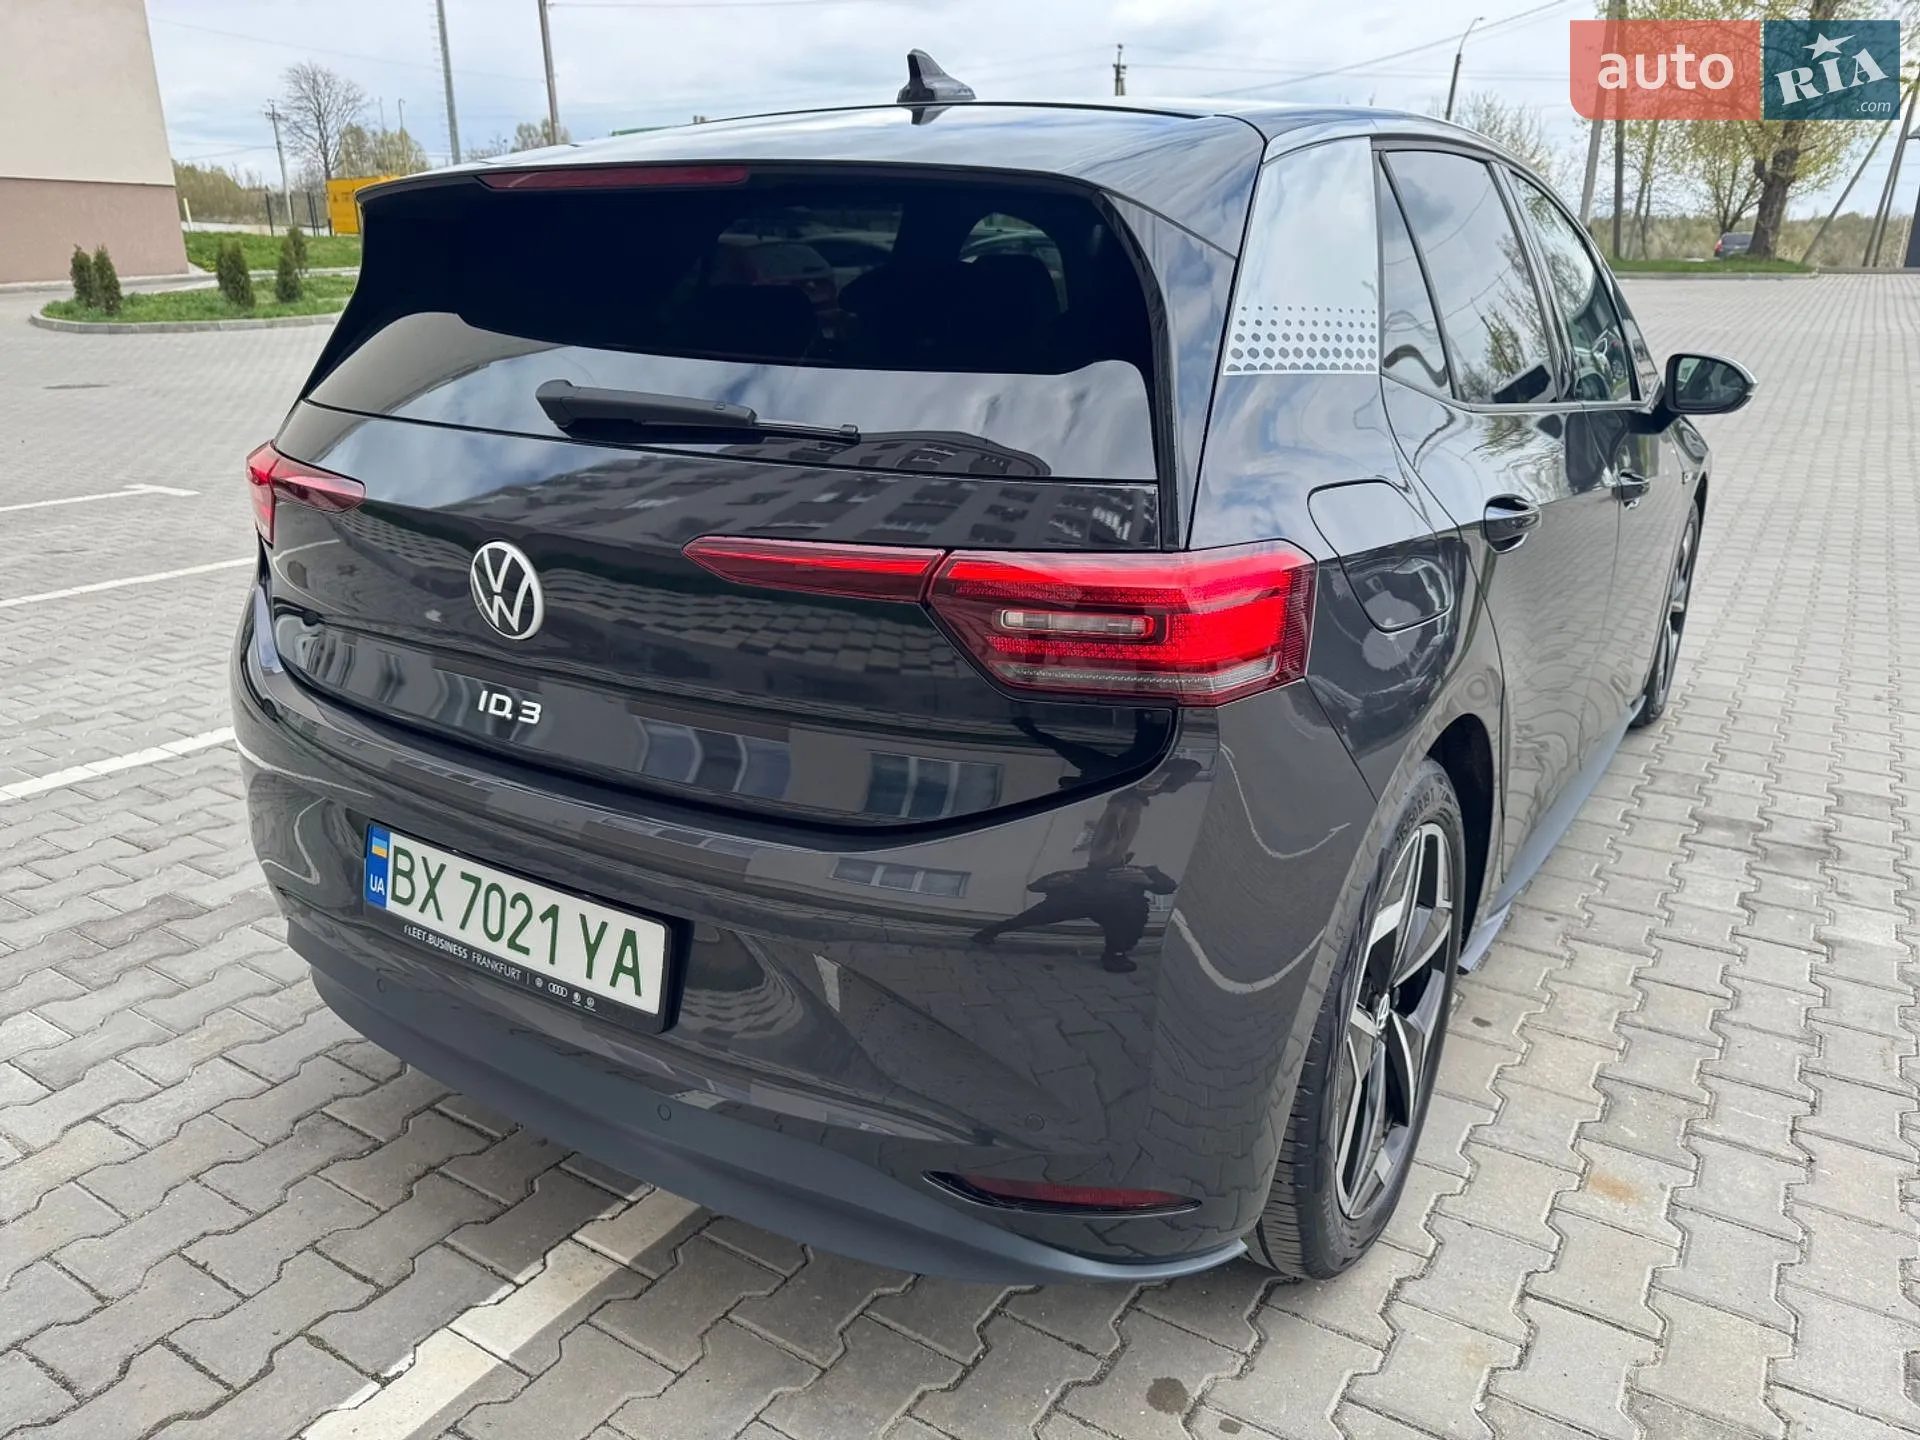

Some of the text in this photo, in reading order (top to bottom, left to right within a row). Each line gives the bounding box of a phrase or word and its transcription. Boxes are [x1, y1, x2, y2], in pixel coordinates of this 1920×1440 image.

[369, 873, 386, 896] UA
[390, 845, 642, 997] BX 7021 YA
[471, 952, 521, 980] FRANKFURT
